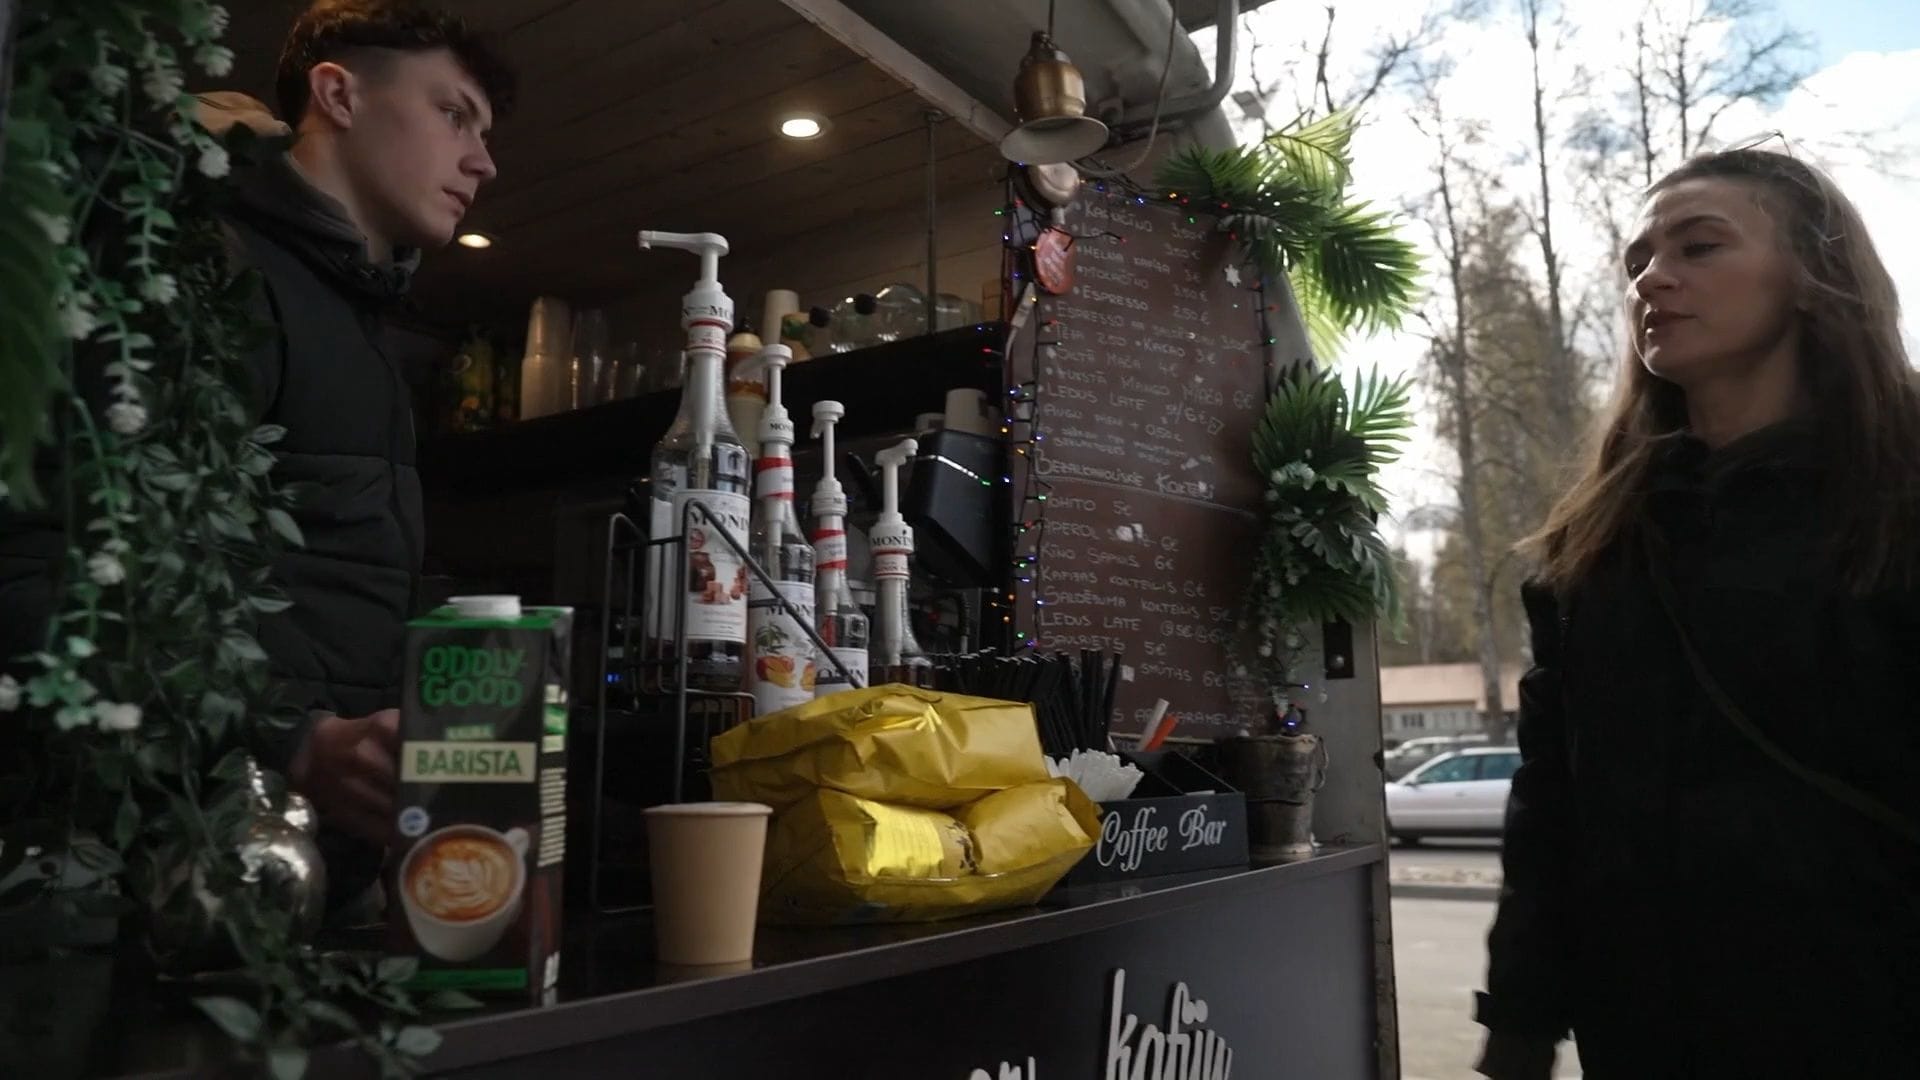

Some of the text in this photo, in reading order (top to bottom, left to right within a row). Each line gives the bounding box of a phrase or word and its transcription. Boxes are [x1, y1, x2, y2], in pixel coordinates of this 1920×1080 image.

[1082, 285, 1149, 310] ESPRESSO
[1056, 300, 1124, 327] ESPRESSO
[1040, 609, 1092, 627] LEDUS
[1103, 616, 1142, 631] LATE
[423, 675, 524, 708] GOOD
[416, 750, 521, 775] BARISTA
[1096, 804, 1228, 872] Coffee Bar
